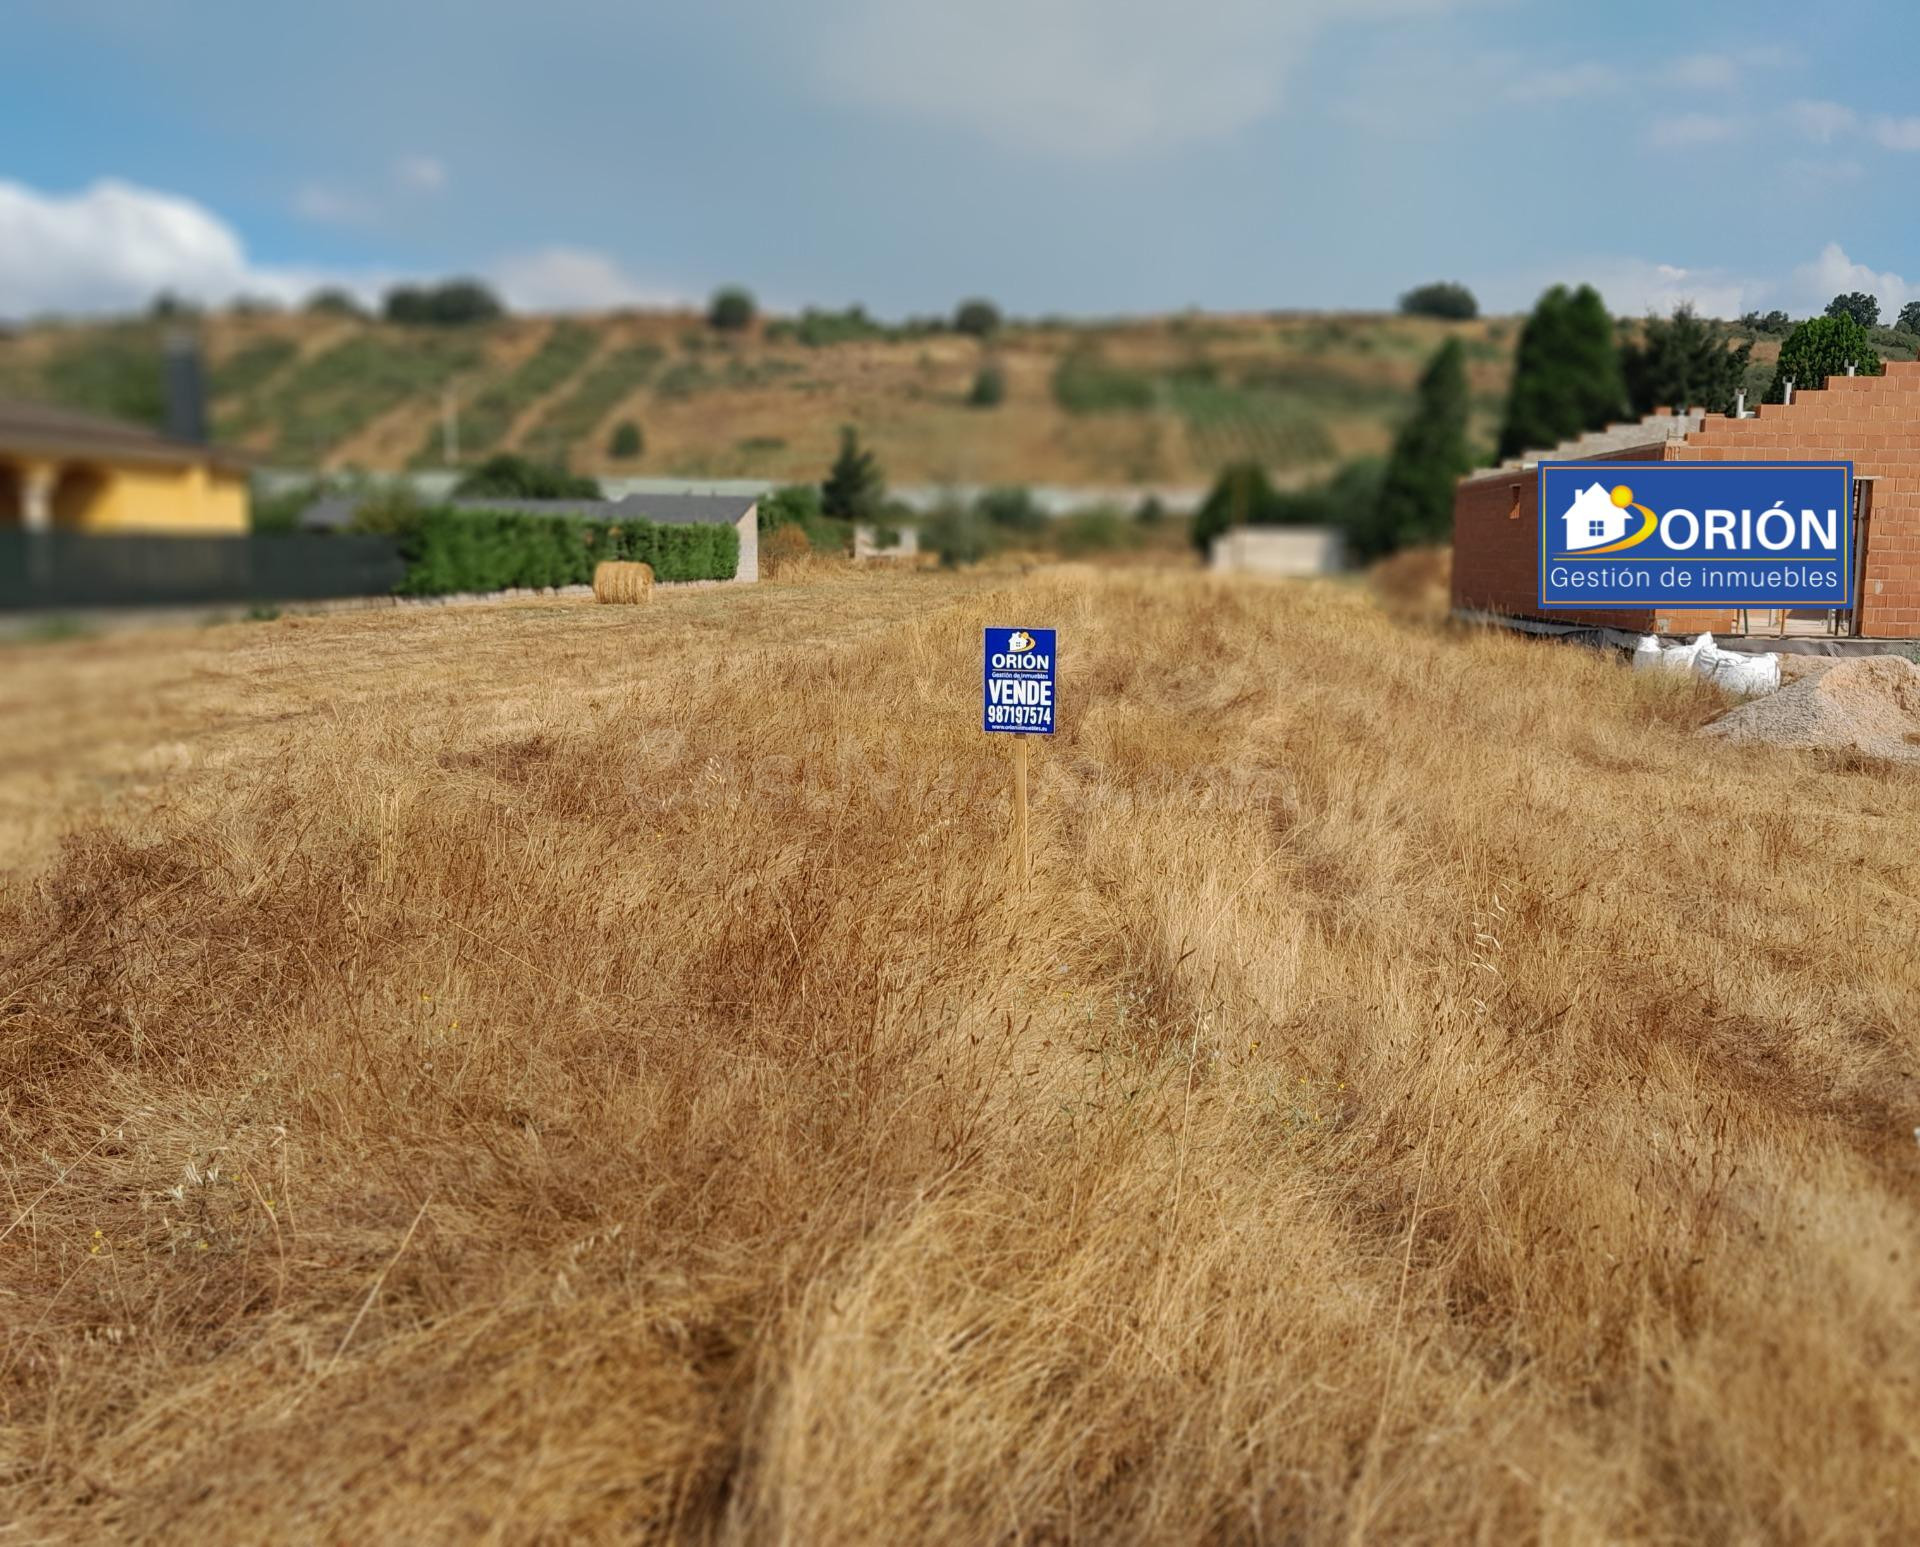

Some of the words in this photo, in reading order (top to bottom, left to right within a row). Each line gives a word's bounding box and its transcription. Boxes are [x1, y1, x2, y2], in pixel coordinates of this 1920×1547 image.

[992, 652, 1049, 669] ORIÓN
[988, 679, 1052, 706] VENDE
[988, 705, 1051, 725] 987197574
